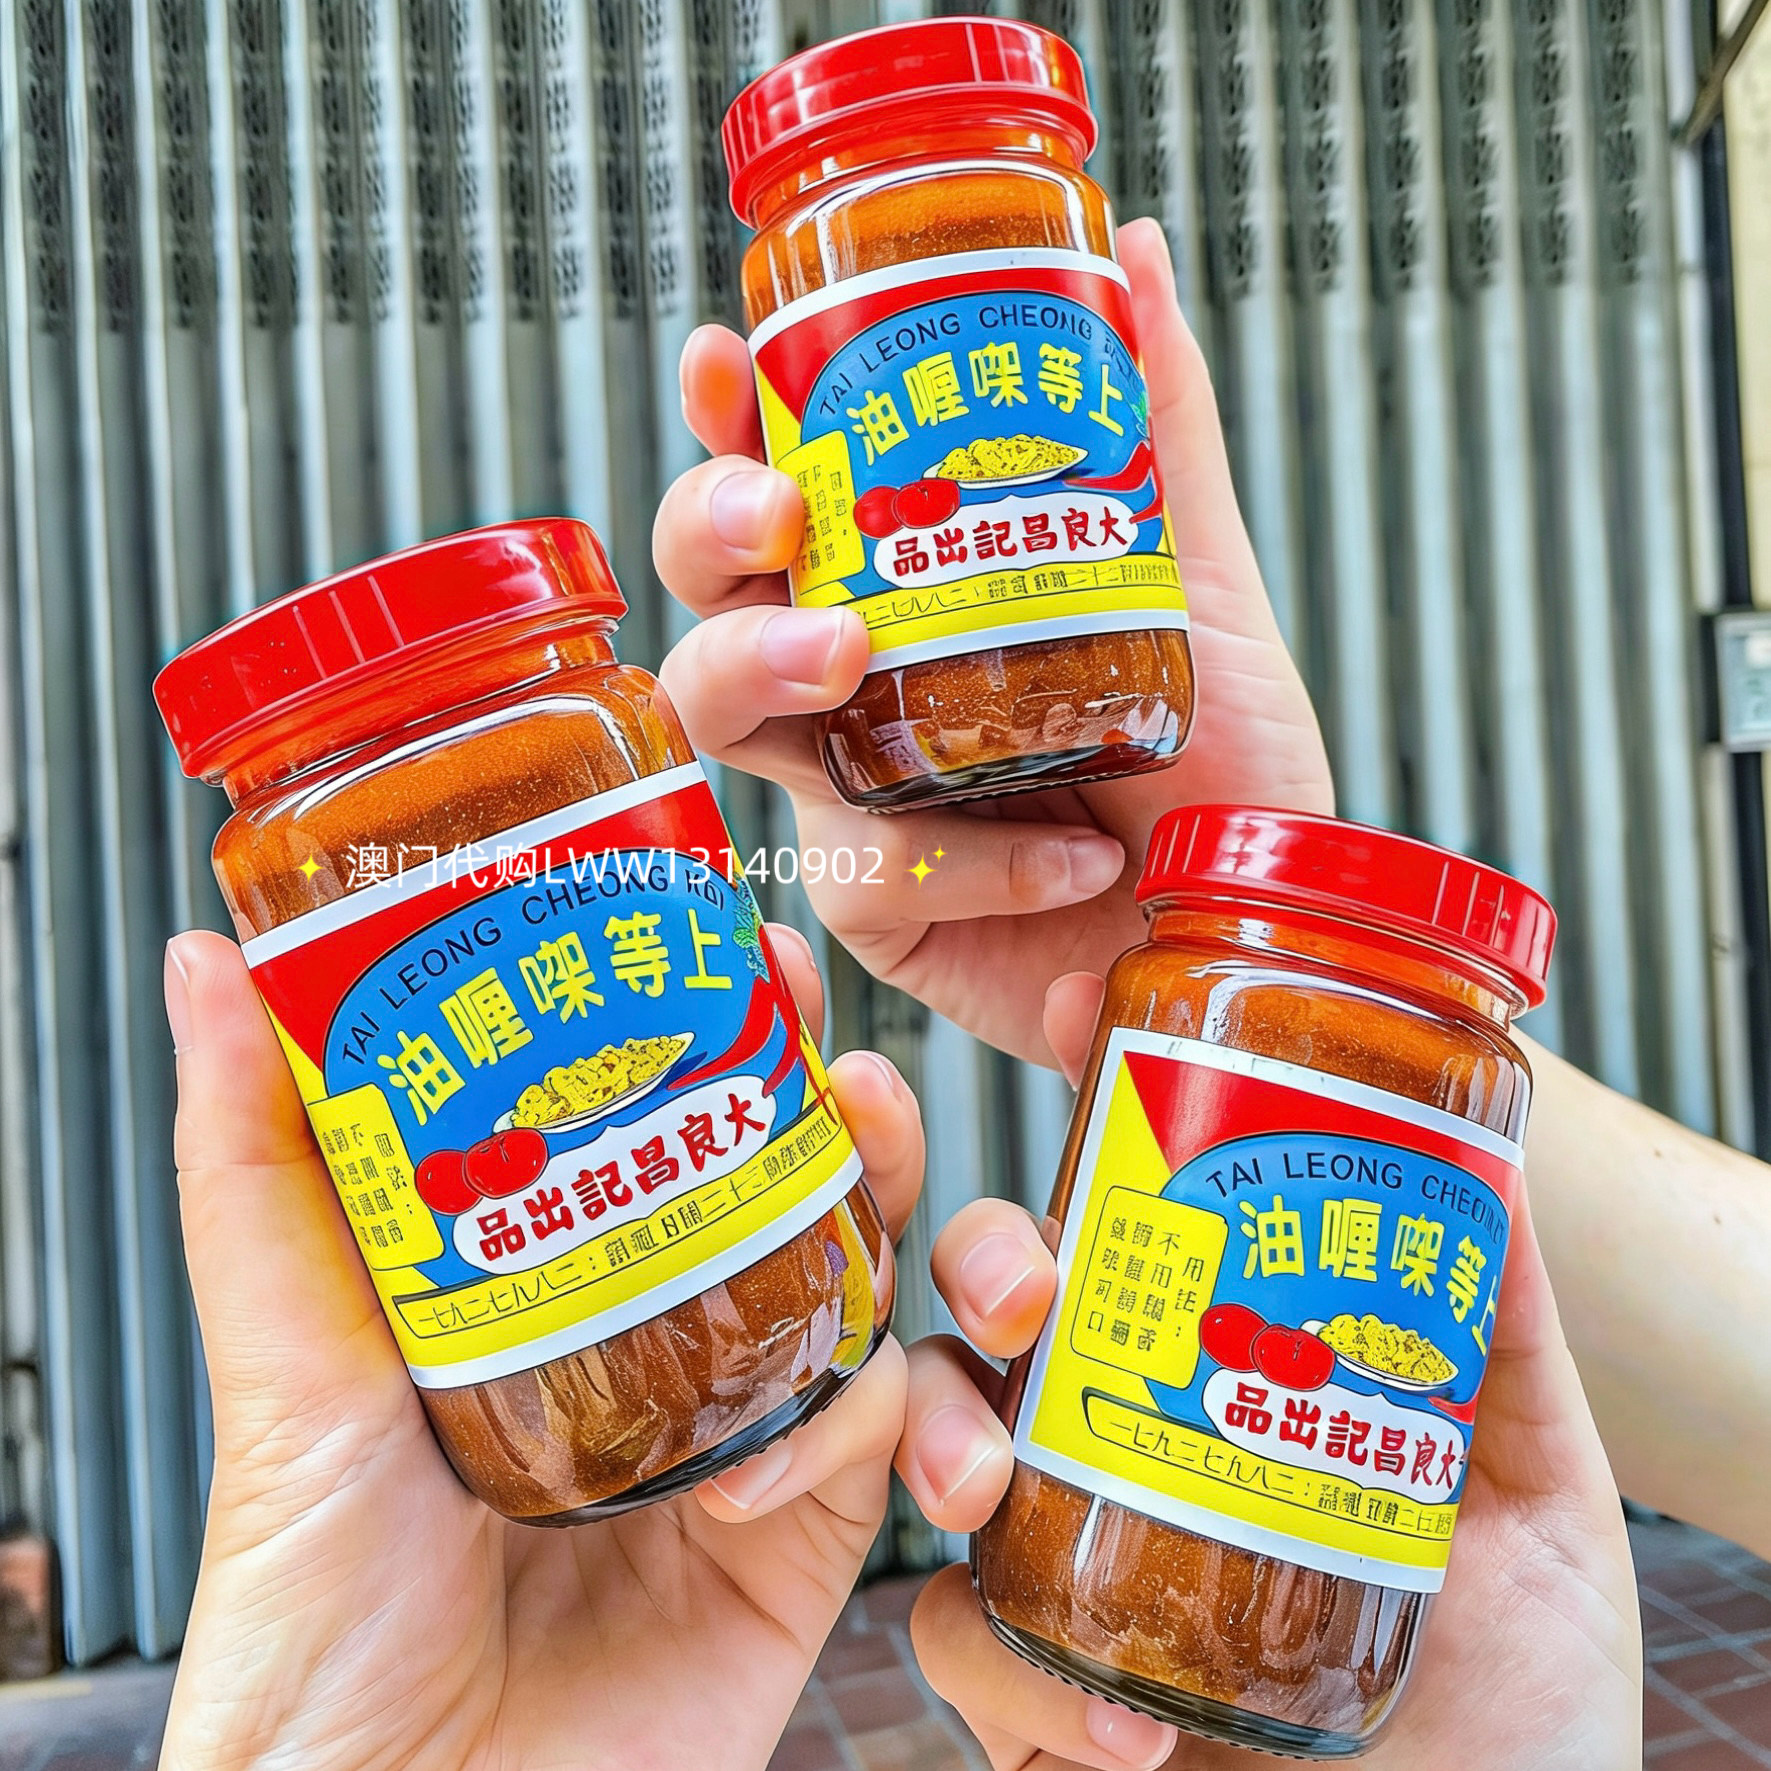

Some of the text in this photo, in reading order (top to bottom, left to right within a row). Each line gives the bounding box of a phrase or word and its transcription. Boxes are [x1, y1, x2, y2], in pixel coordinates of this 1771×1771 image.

[819, 372, 853, 415] TAI
[859, 312, 961, 373] LEONG
[343, 1011, 381, 1066] TAI
[379, 917, 502, 1010] LEONG
[521, 865, 669, 926] CHEONG
[1206, 1157, 1263, 1198] TAI
[1283, 1151, 1403, 1189] LEONG
